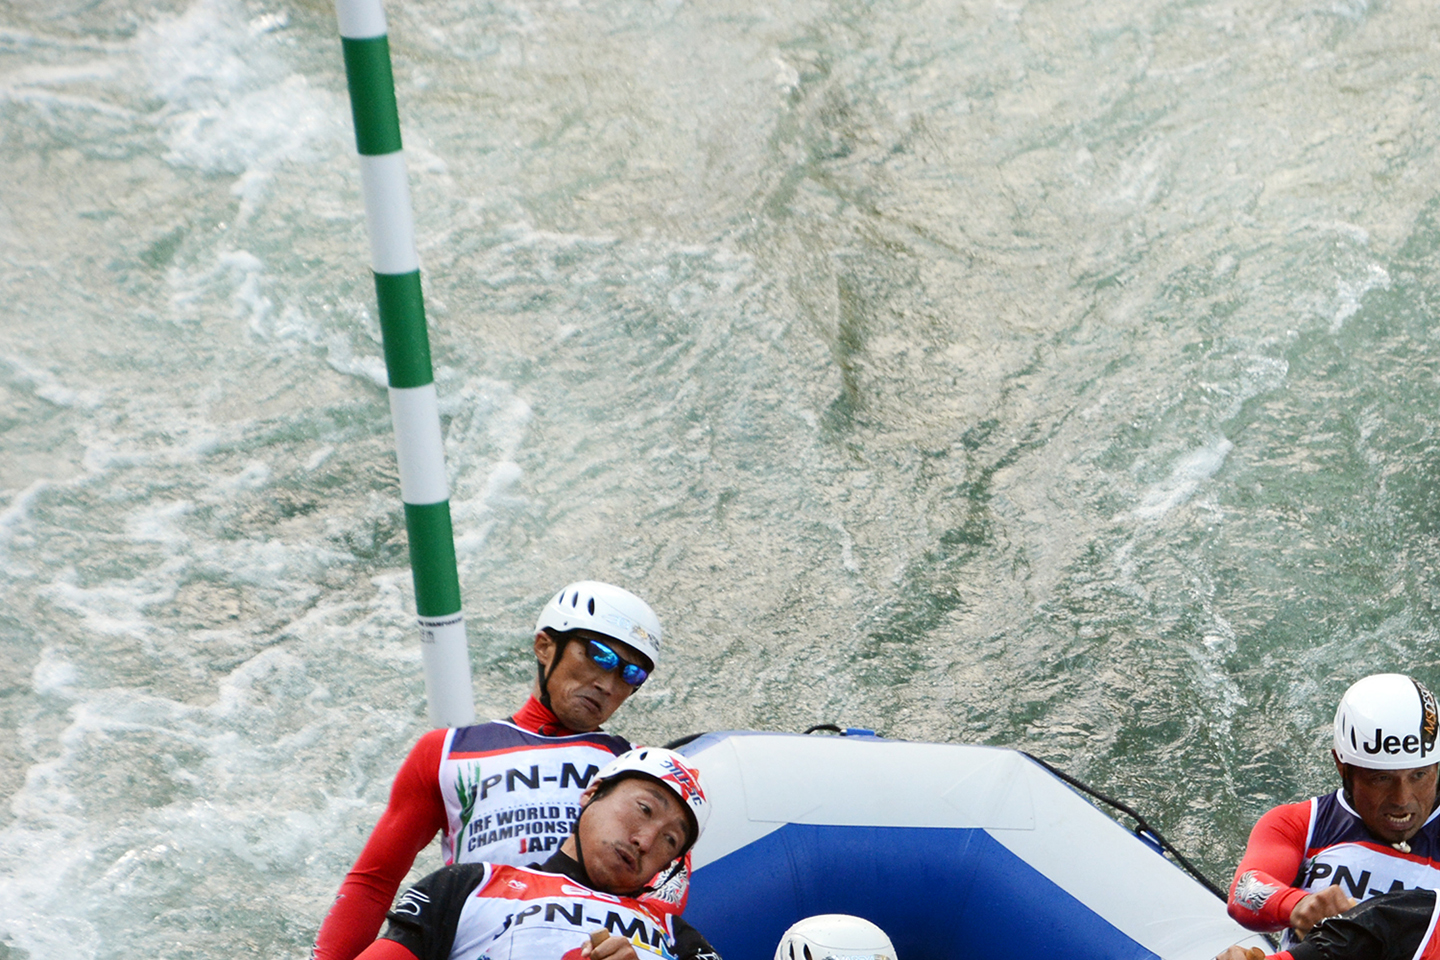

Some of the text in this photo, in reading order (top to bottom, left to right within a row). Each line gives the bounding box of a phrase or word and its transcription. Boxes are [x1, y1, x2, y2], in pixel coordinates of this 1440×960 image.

[1363, 728, 1435, 758] Jeep
[469, 806, 581, 837] IRF WORLD R
